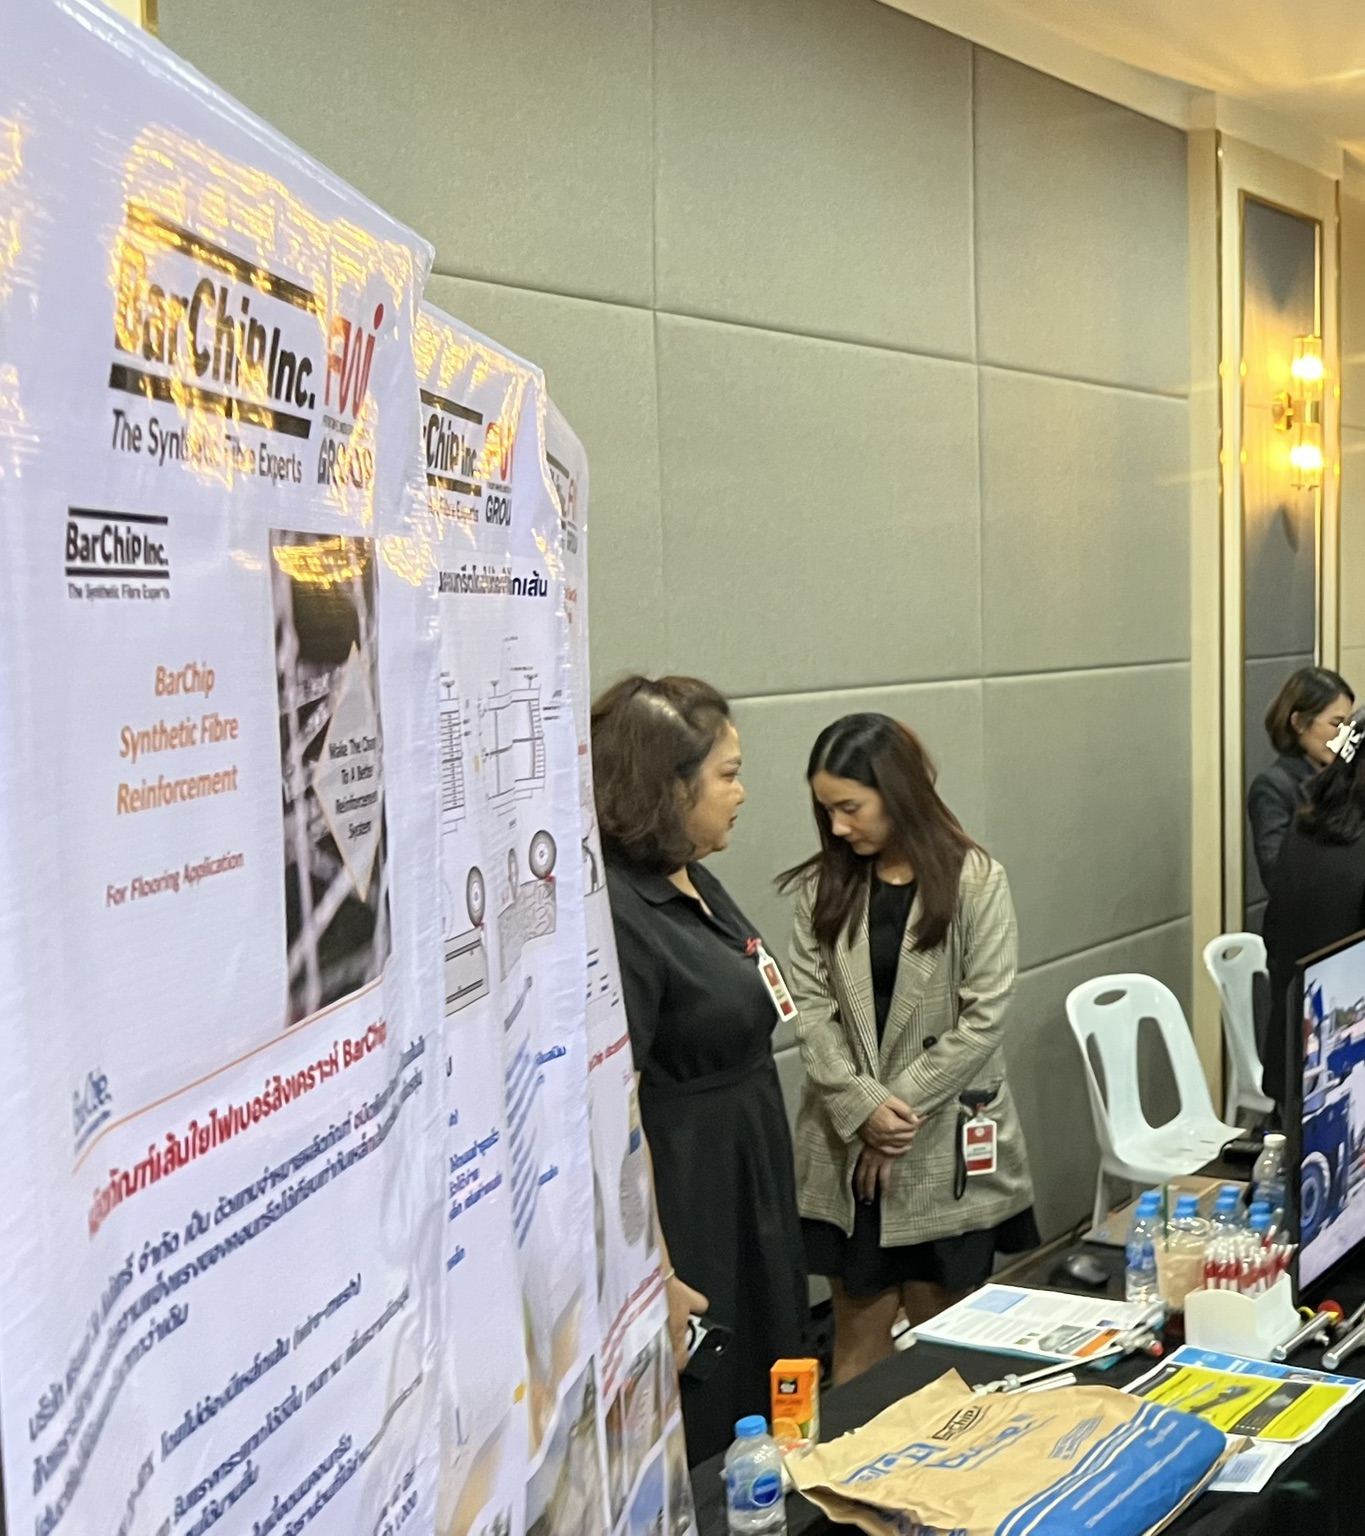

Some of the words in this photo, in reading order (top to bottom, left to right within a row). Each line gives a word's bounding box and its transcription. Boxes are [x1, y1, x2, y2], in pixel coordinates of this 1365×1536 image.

[267, 326, 316, 411] Inc.
[112, 408, 143, 453] The
[258, 442, 302, 486] Experts
[65, 520, 141, 565] BarChip
[143, 534, 169, 566] Inc.
[154, 661, 216, 699] BarChip
[119, 716, 198, 765] Synthetic
[200, 712, 239, 745] Fibre
[116, 764, 239, 816] Reinforcement
[106, 884, 129, 907] For
[130, 870, 181, 901] Flooring
[183, 851, 245, 888] Application
